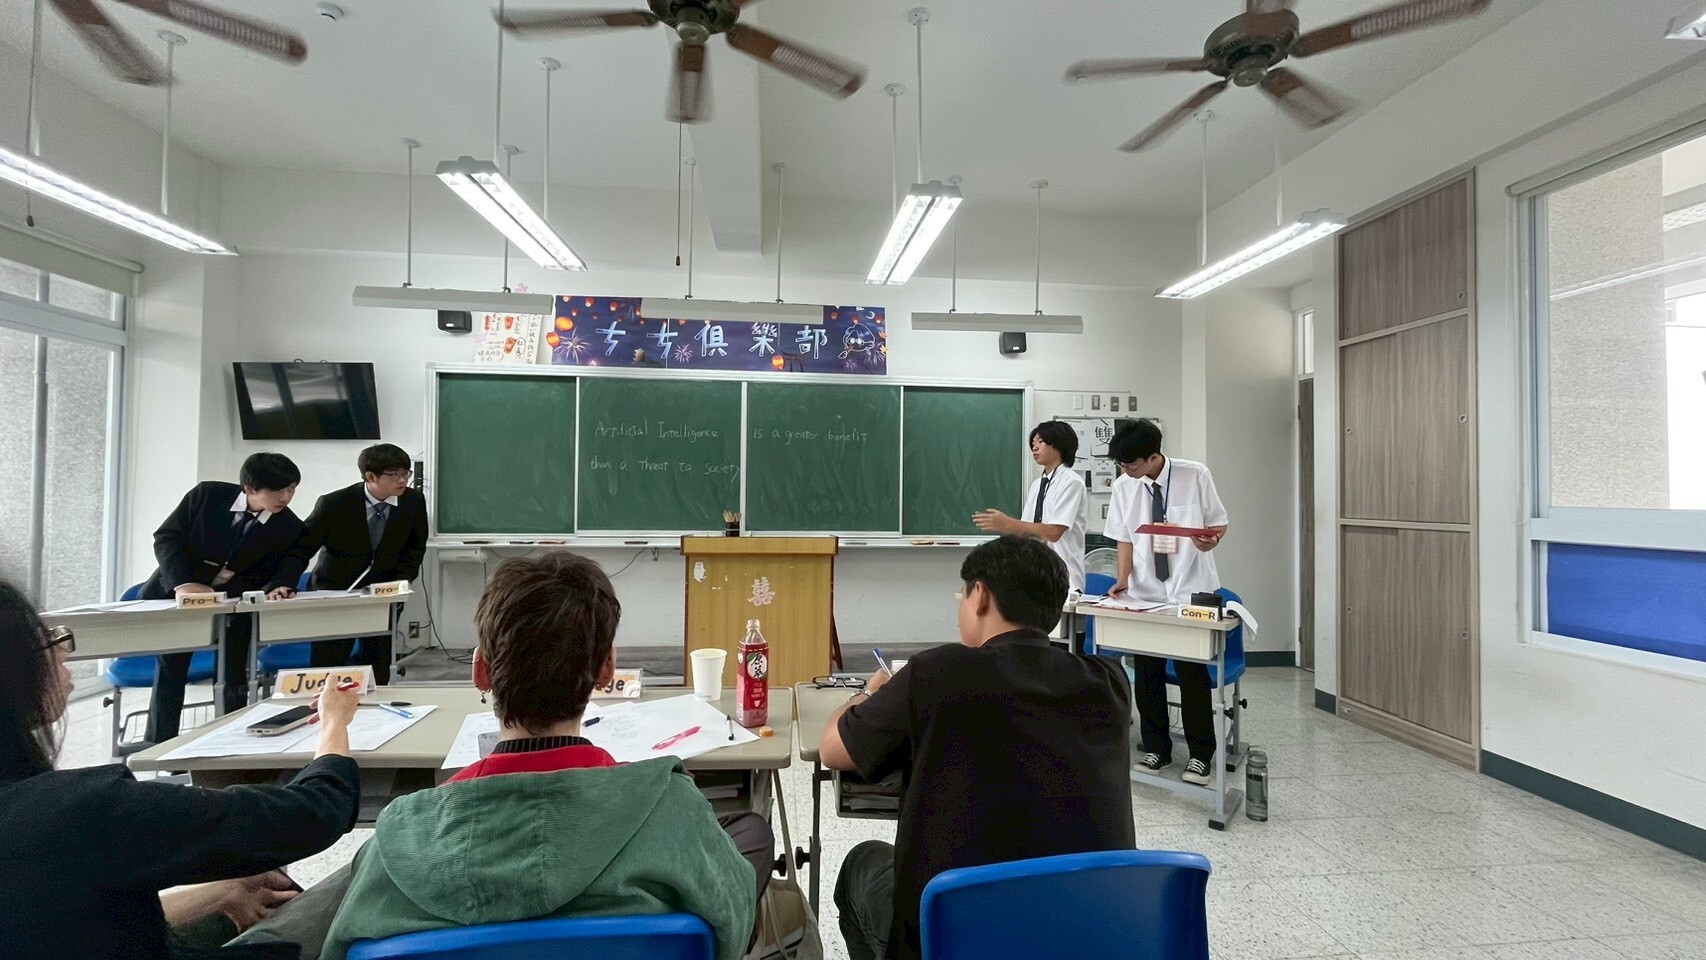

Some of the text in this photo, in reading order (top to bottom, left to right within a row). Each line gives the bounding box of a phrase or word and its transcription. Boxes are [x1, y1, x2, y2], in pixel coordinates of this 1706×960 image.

[594, 420, 648, 438] Artificial
[657, 421, 719, 443] Intelligence
[772, 429, 781, 439] a
[784, 429, 819, 446] greater
[828, 427, 869, 441] benefit
[590, 455, 611, 470] than
[619, 460, 628, 471] a
[1181, 608, 1216, 620] Con-R
